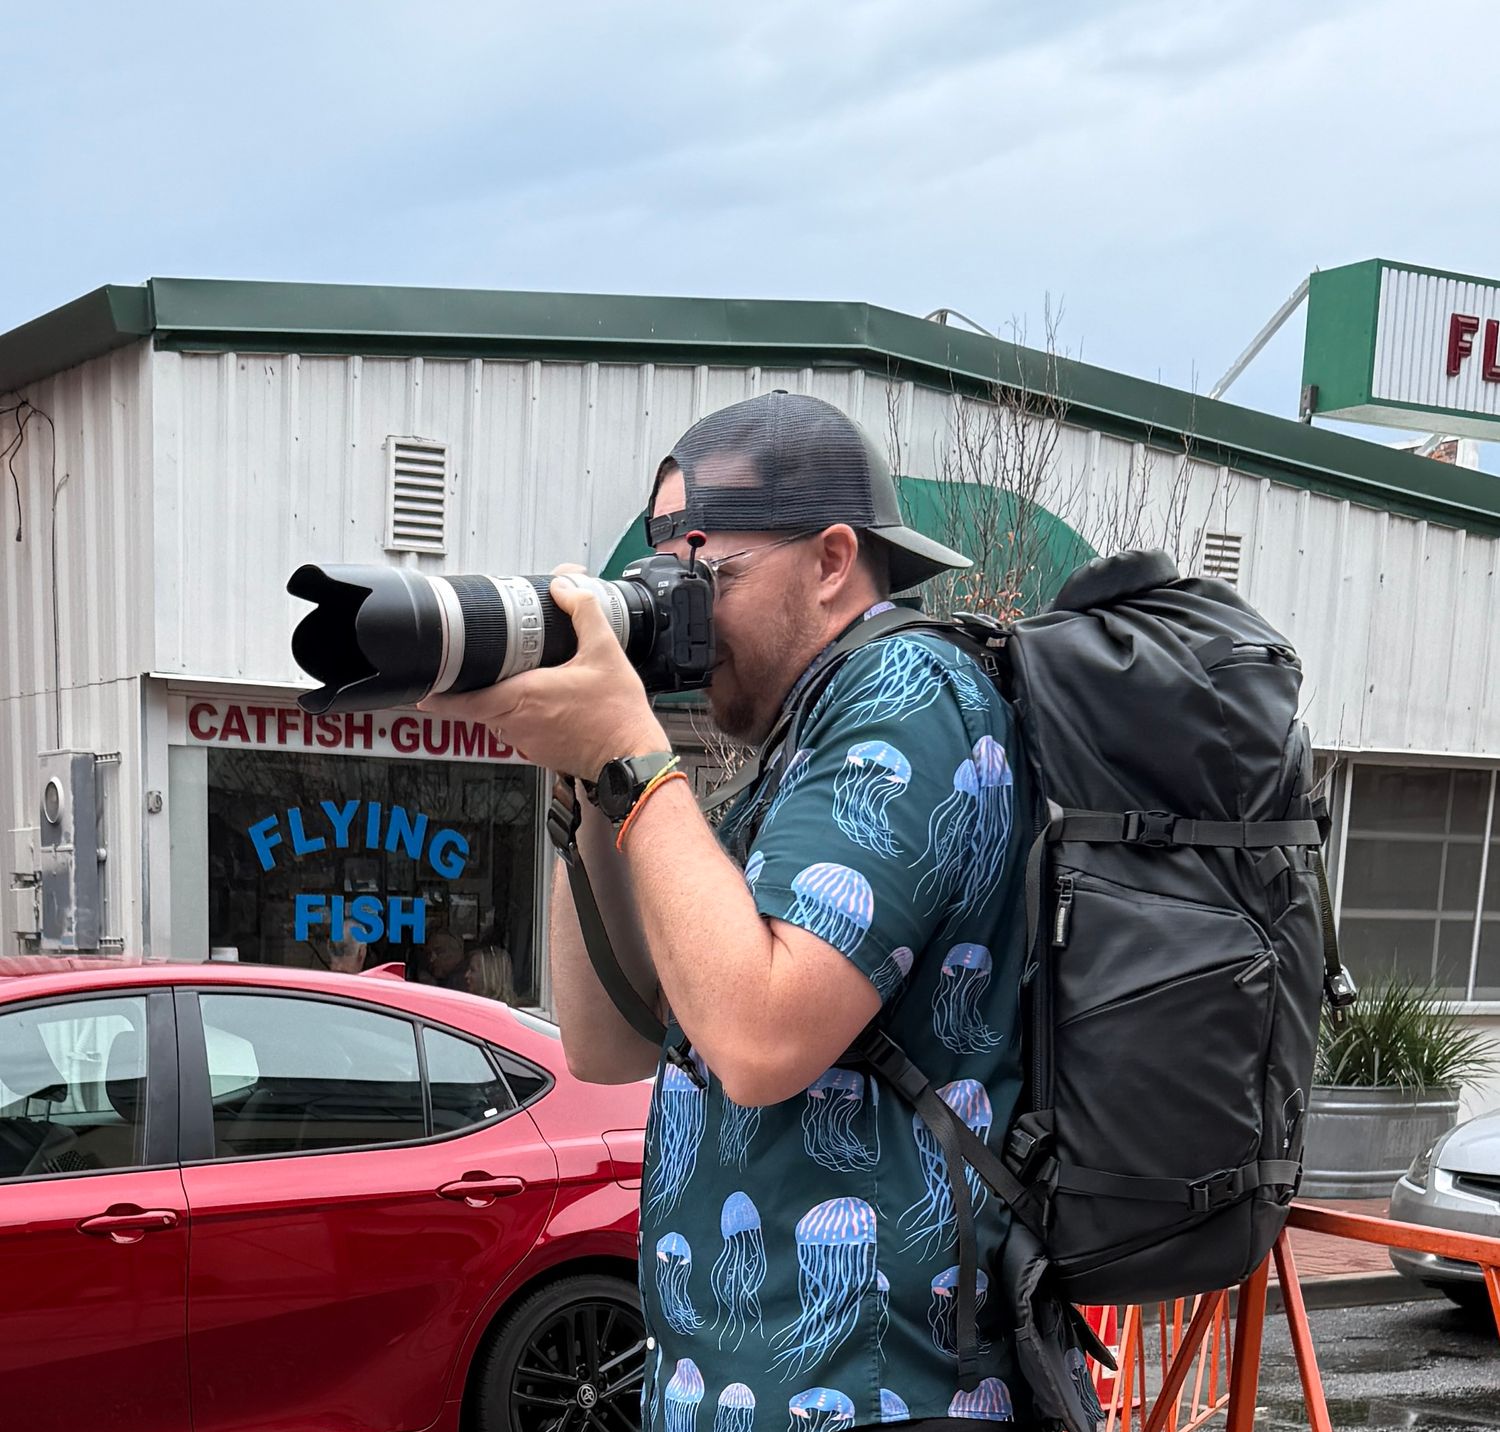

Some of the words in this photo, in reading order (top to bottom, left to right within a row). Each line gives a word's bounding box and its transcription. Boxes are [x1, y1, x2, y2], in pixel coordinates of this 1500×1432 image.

[390, 716, 529, 760] GUMB
[248, 799, 470, 880] FLYING
[294, 894, 427, 944] FISH
